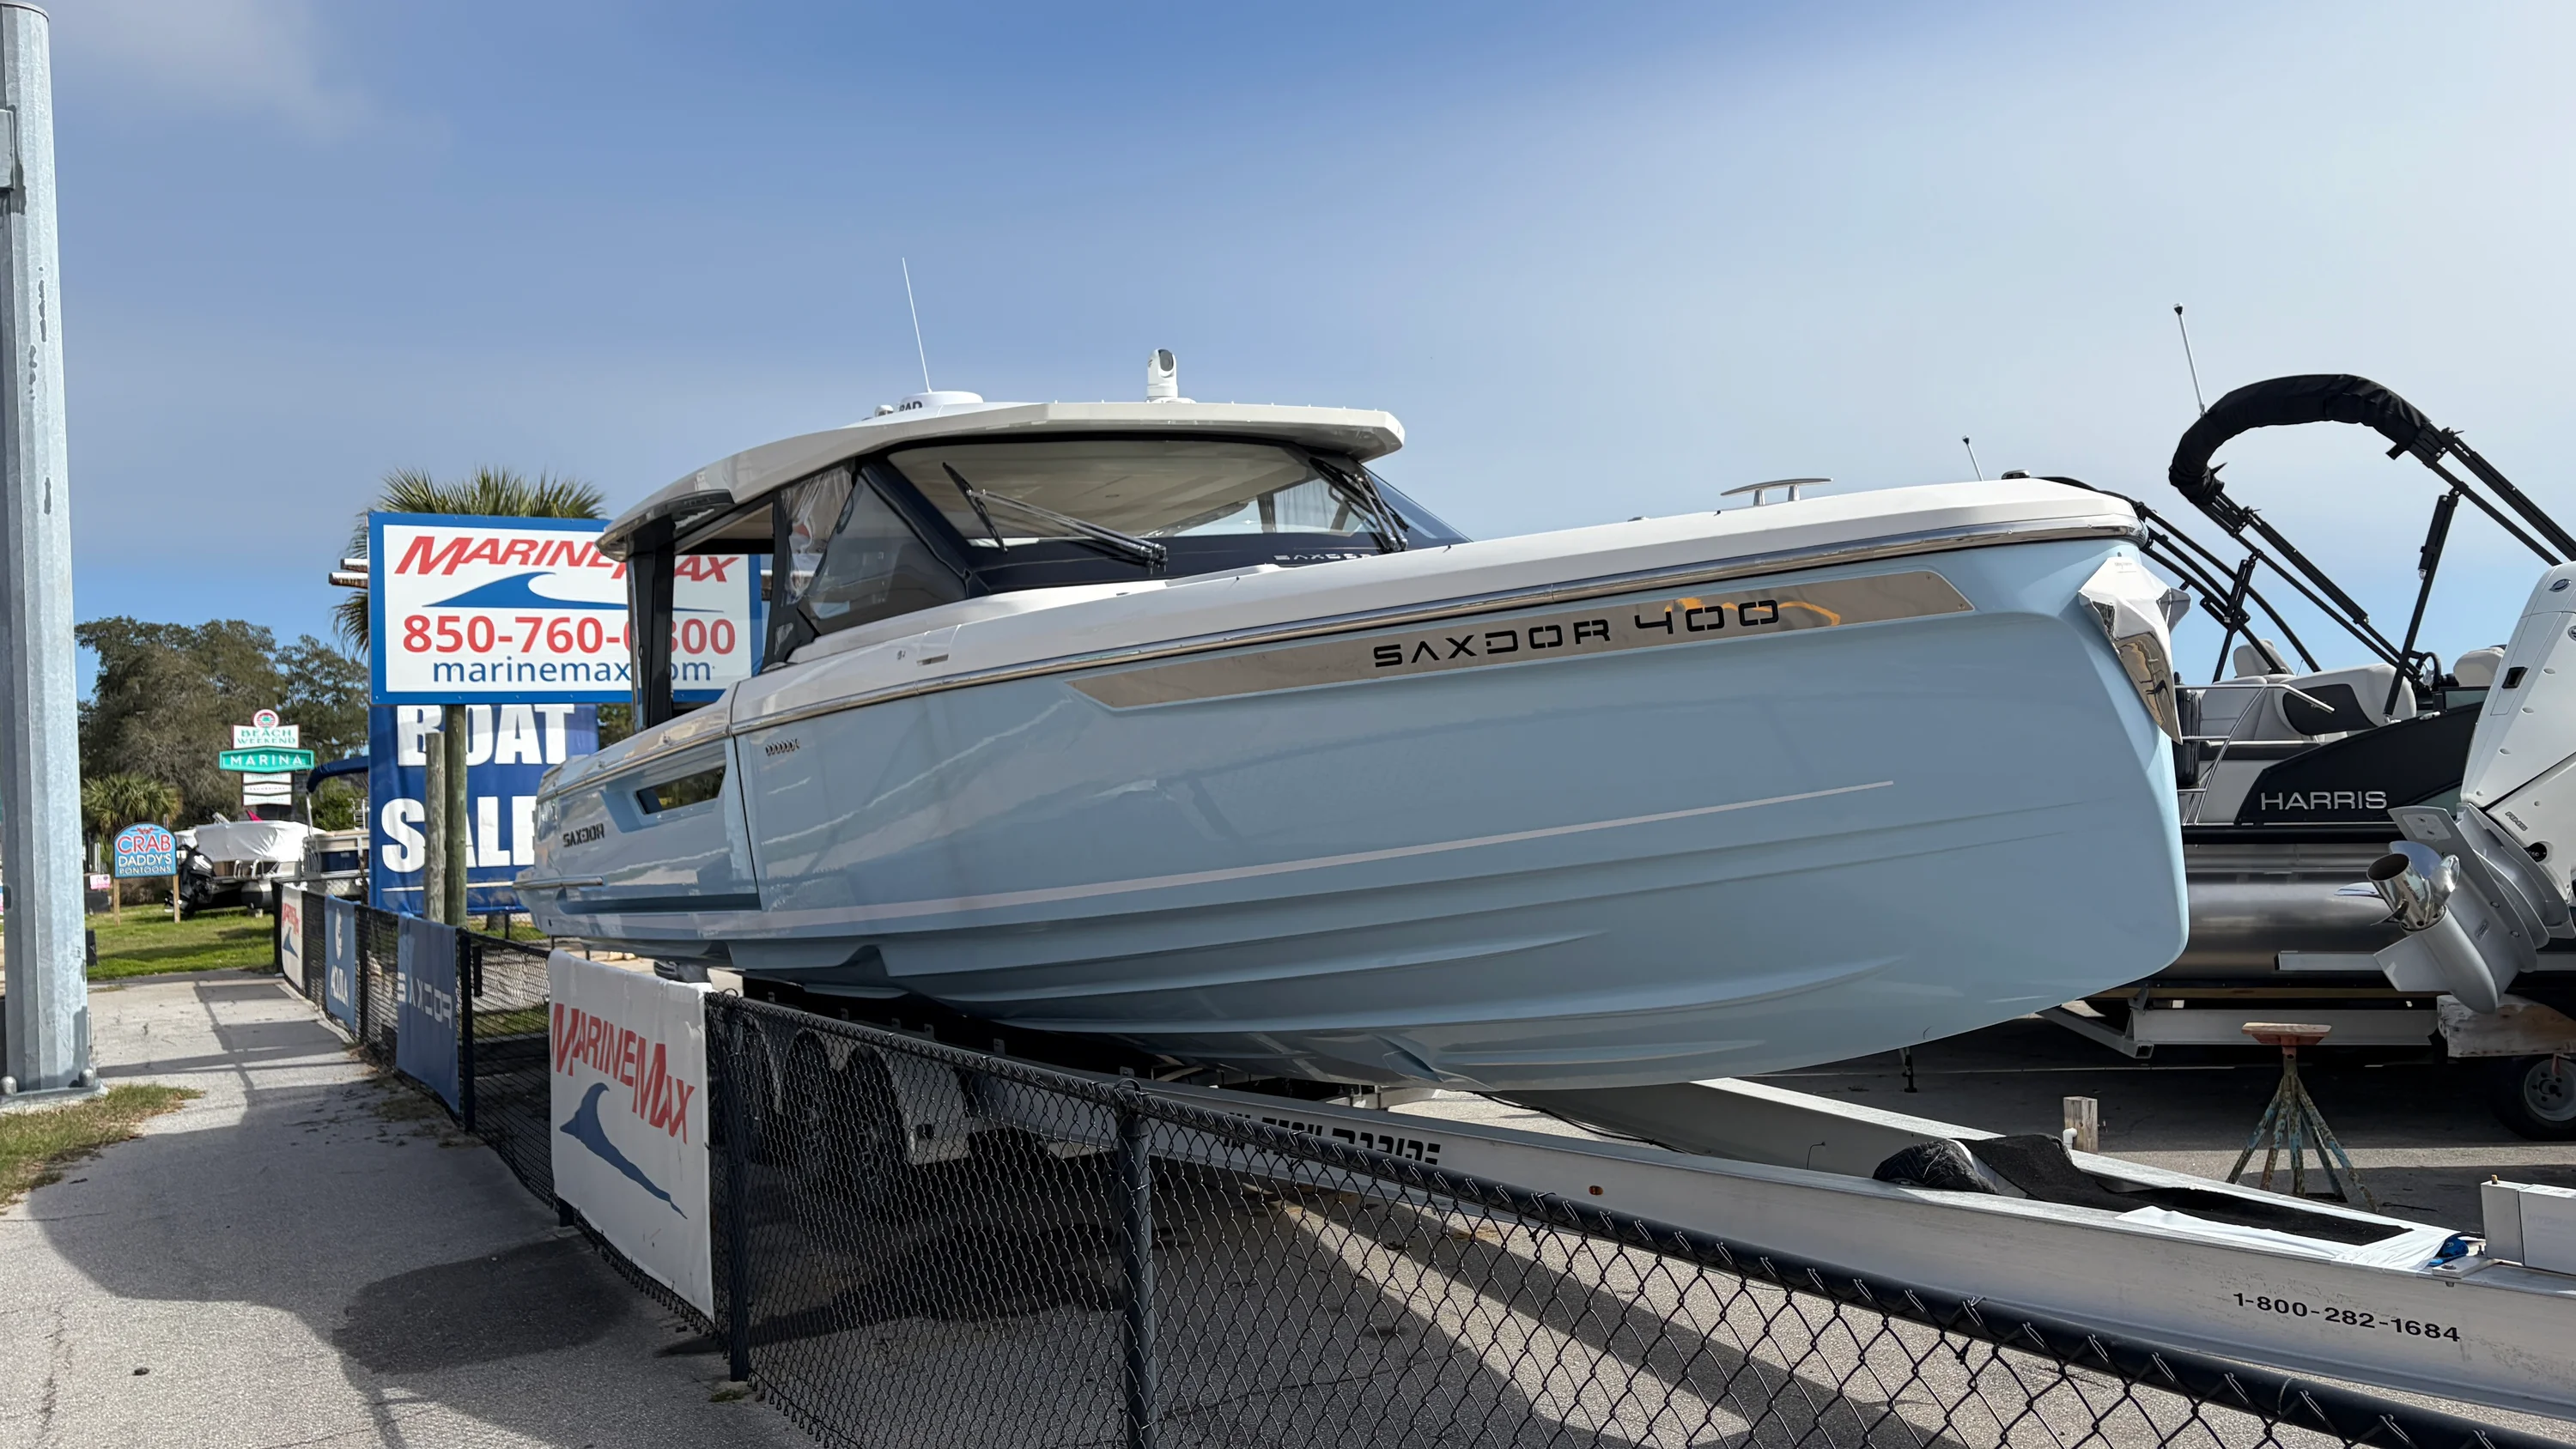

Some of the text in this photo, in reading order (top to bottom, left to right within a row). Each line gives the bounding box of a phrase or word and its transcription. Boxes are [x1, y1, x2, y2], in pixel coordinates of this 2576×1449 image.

[395, 536, 740, 583] MARINEAX
[403, 615, 736, 655] 850-760-00
[1373, 599, 1780, 668] SAXDOR 400
[240, 726, 292, 737] BEACH
[397, 704, 575, 767] BOAT
[229, 754, 303, 767] MARINA
[2260, 791, 2388, 810] HARRIS
[117, 834, 172, 855] CRAB
[381, 795, 537, 873] SLE
[562, 822, 605, 848] SAXDOR
[118, 853, 172, 868] DADDY'S
[397, 971, 453, 1029] SAXDOR
[551, 1003, 696, 1145] MARINEMAX
[2233, 1292, 2461, 1343] 1-800-282-1684
